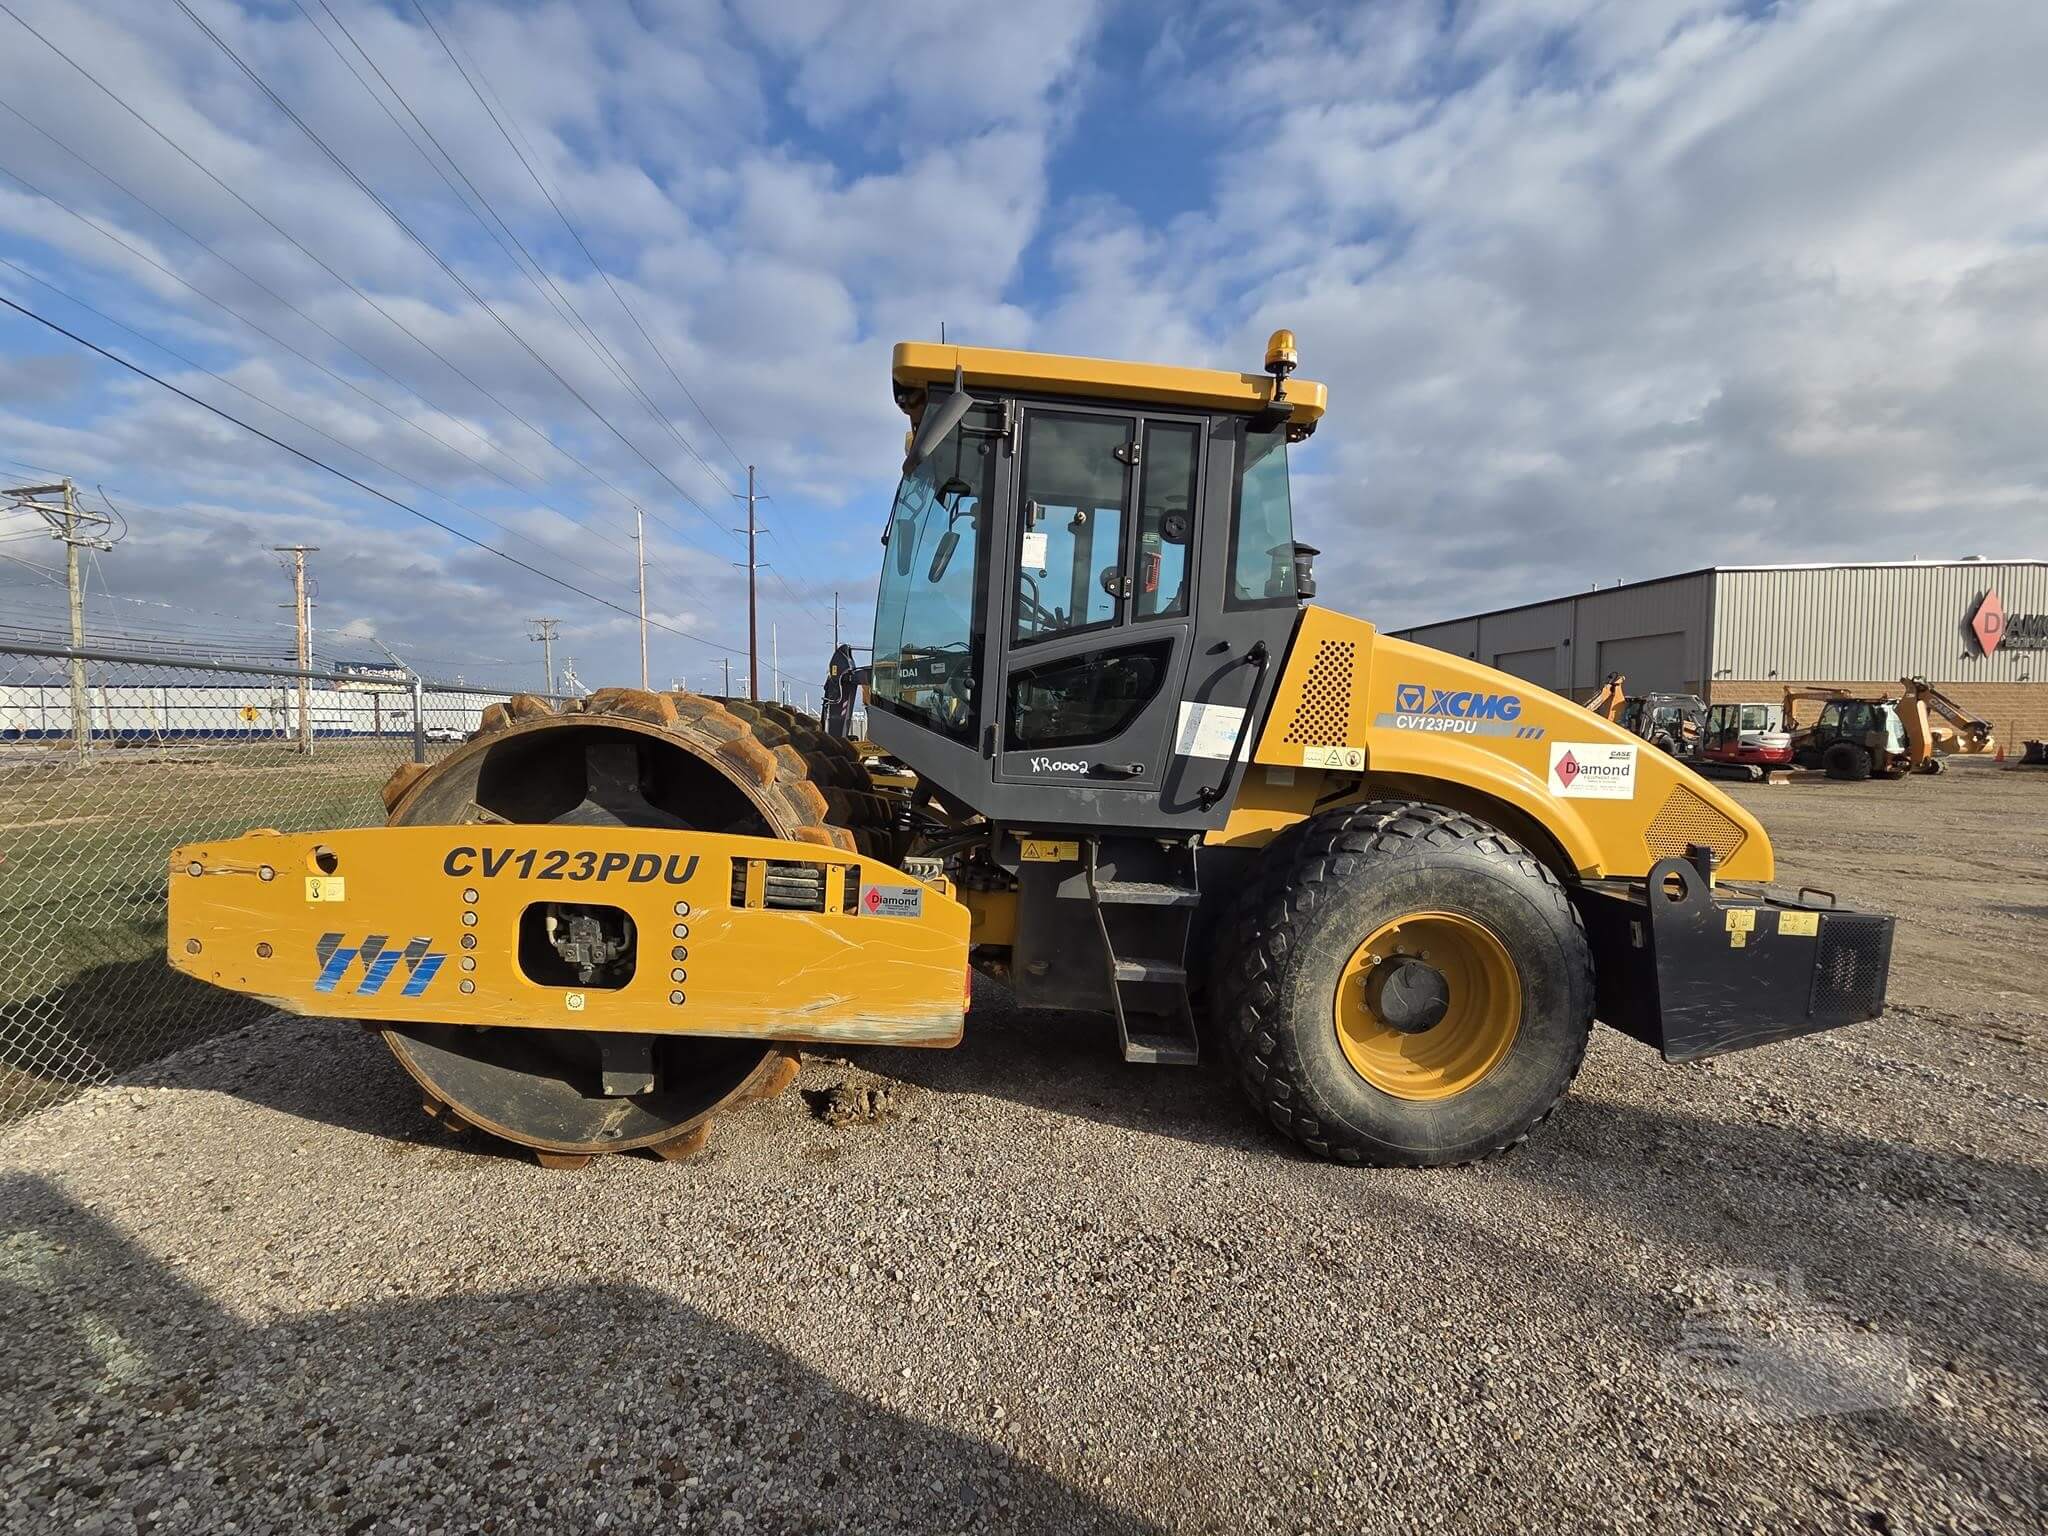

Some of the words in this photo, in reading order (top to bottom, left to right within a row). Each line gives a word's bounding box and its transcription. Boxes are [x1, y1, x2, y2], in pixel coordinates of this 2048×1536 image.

[1424, 690, 1521, 721] XCMG
[1396, 715, 1477, 734] CV123PDU
[1030, 757, 1090, 774] XR0002
[1565, 761, 1630, 776] Diamond
[443, 847, 700, 885] CV123PDU
[871, 895, 918, 906] Diamond
